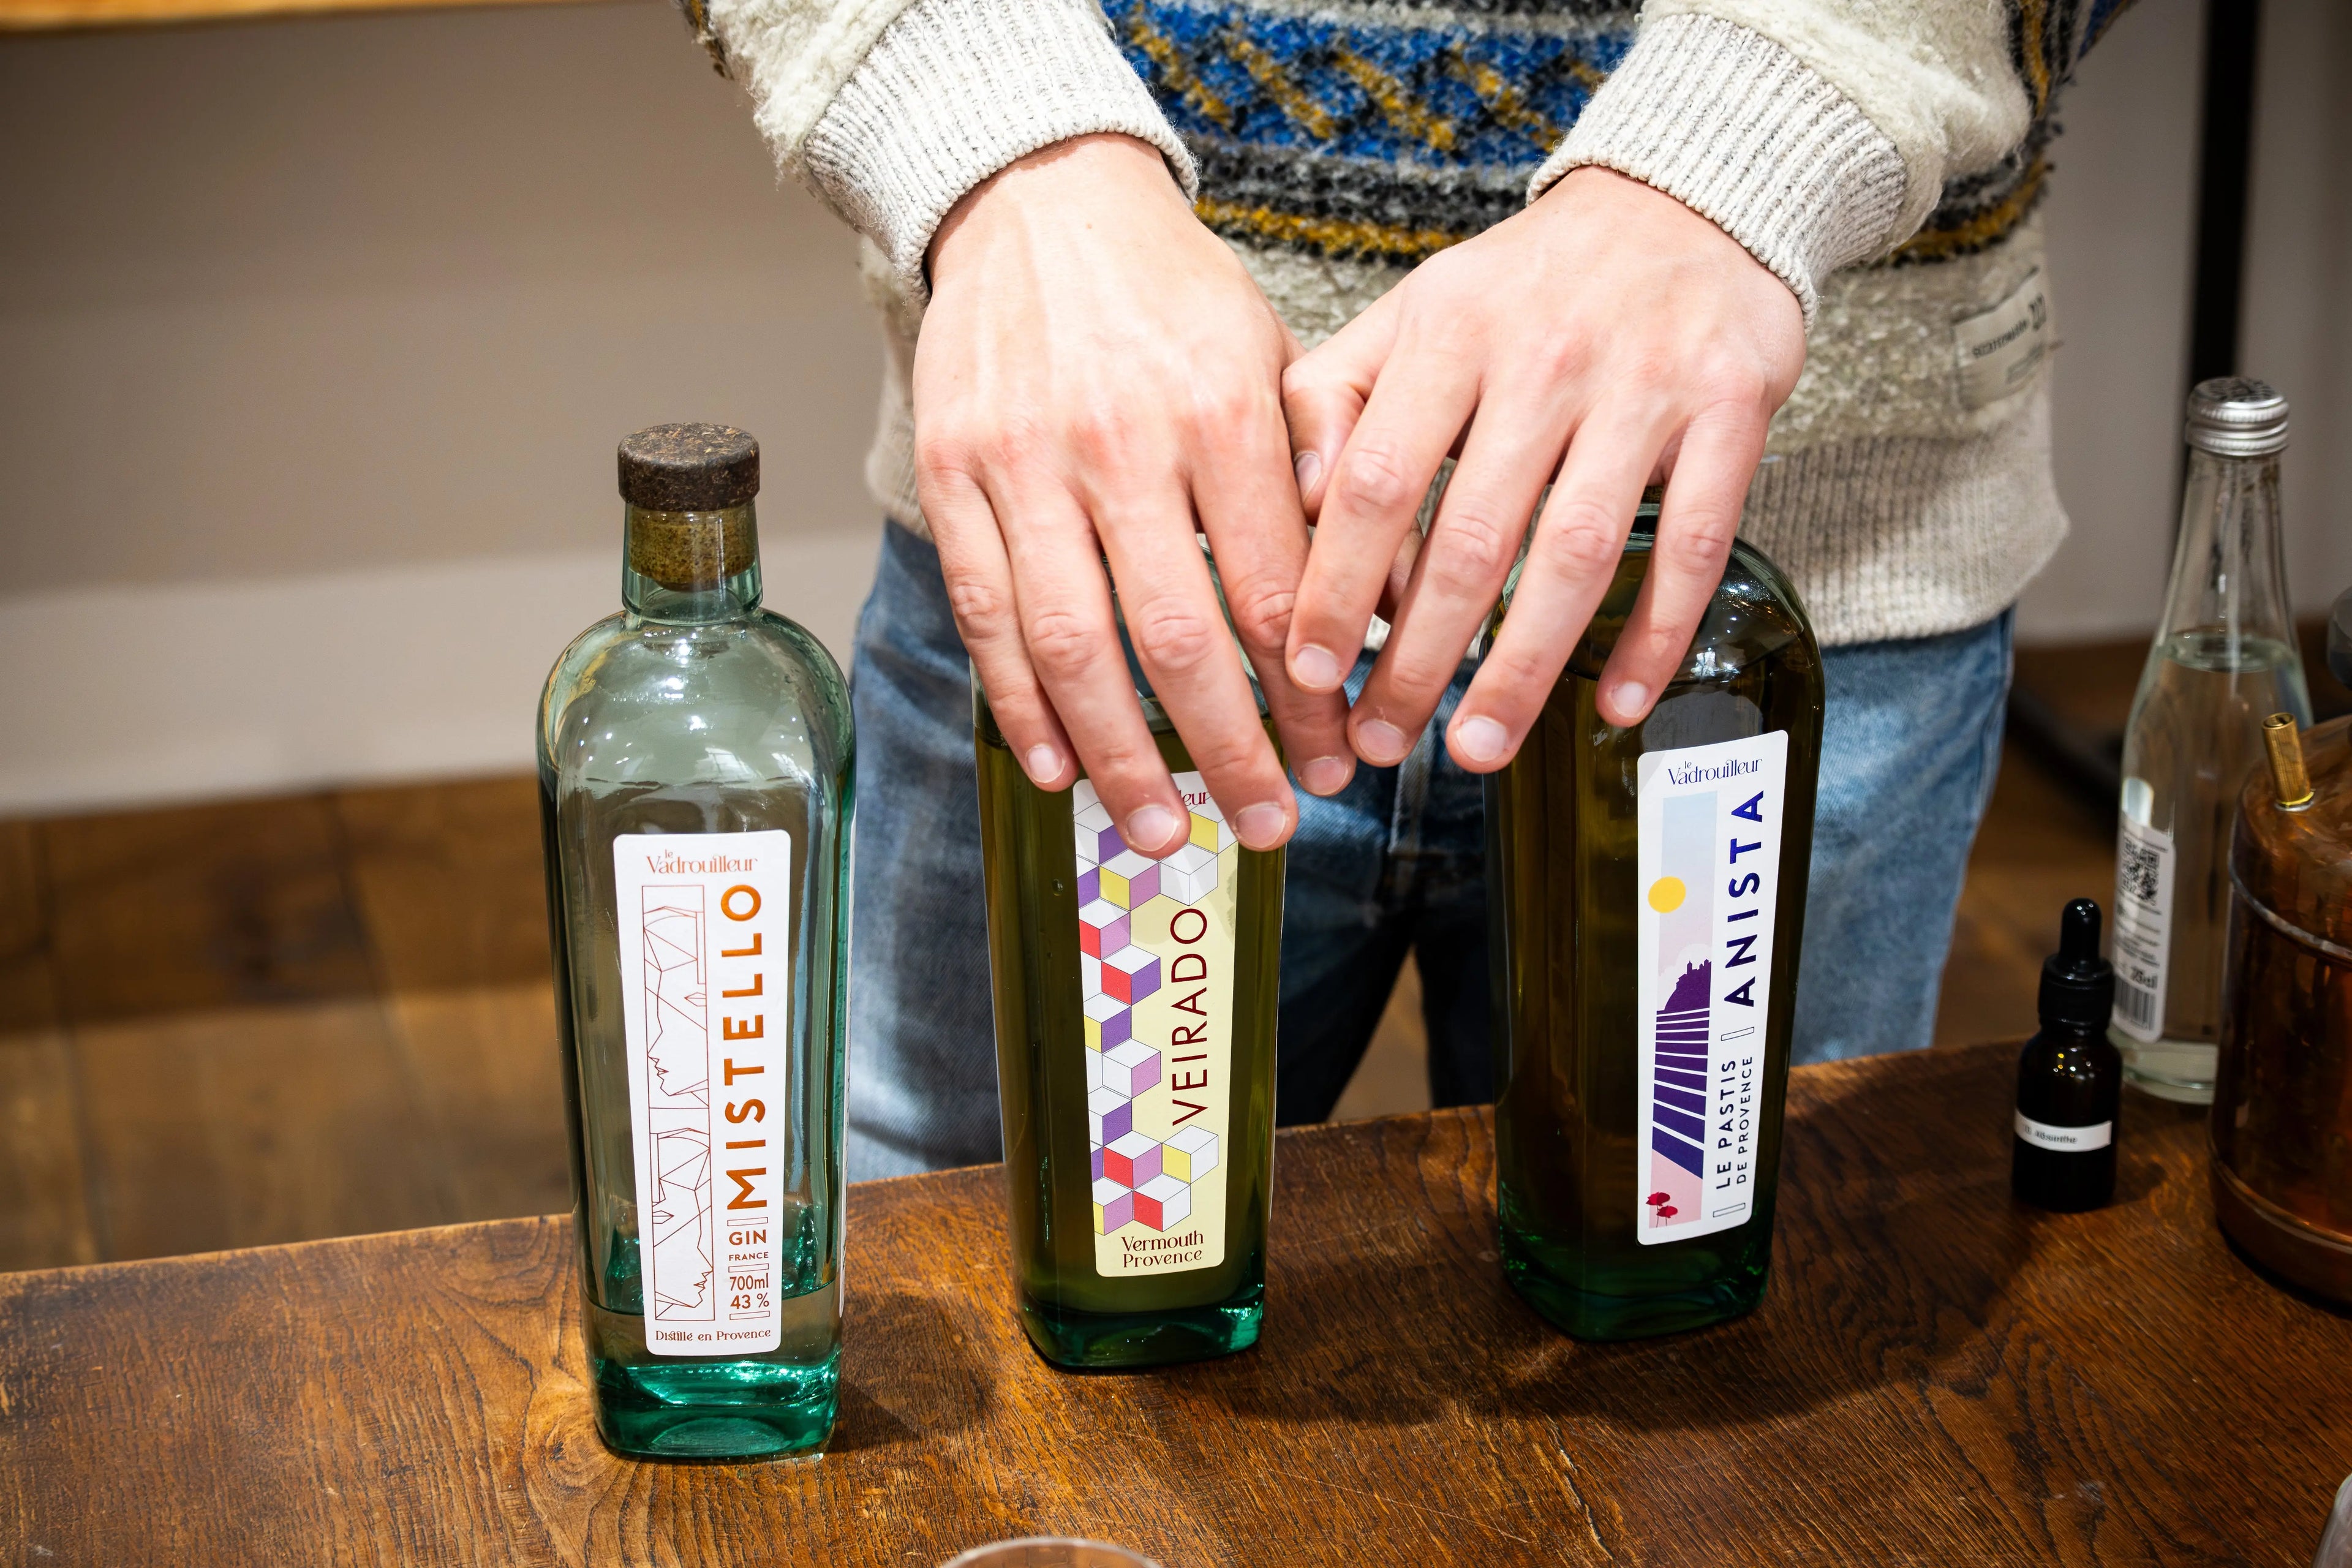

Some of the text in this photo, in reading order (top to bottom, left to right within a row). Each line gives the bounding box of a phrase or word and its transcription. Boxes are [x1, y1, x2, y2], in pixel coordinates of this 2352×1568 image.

[1667, 758, 1762, 785] Vadrouilleur
[1684, 760, 1692, 769] le
[665, 849, 673, 858] le
[646, 855, 758, 874] Vadrouilleur
[1724, 790, 1764, 1007] ANISTA
[1170, 908, 1208, 1126] VEIRADO
[720, 884, 767, 1210] MISTELLO
[1716, 1060, 1736, 1189] LE PASTIS
[1736, 1057, 1752, 1184] DE PROVENCE
[729, 1229, 767, 1246] GIN
[1121, 1230, 1204, 1252] Vermouth
[729, 1251, 769, 1261] FRANCE
[1123, 1250, 1202, 1268] Provence
[729, 1273, 769, 1291] 700ml
[730, 1292, 770, 1310] 43 %
[717, 1329, 772, 1341] Provence
